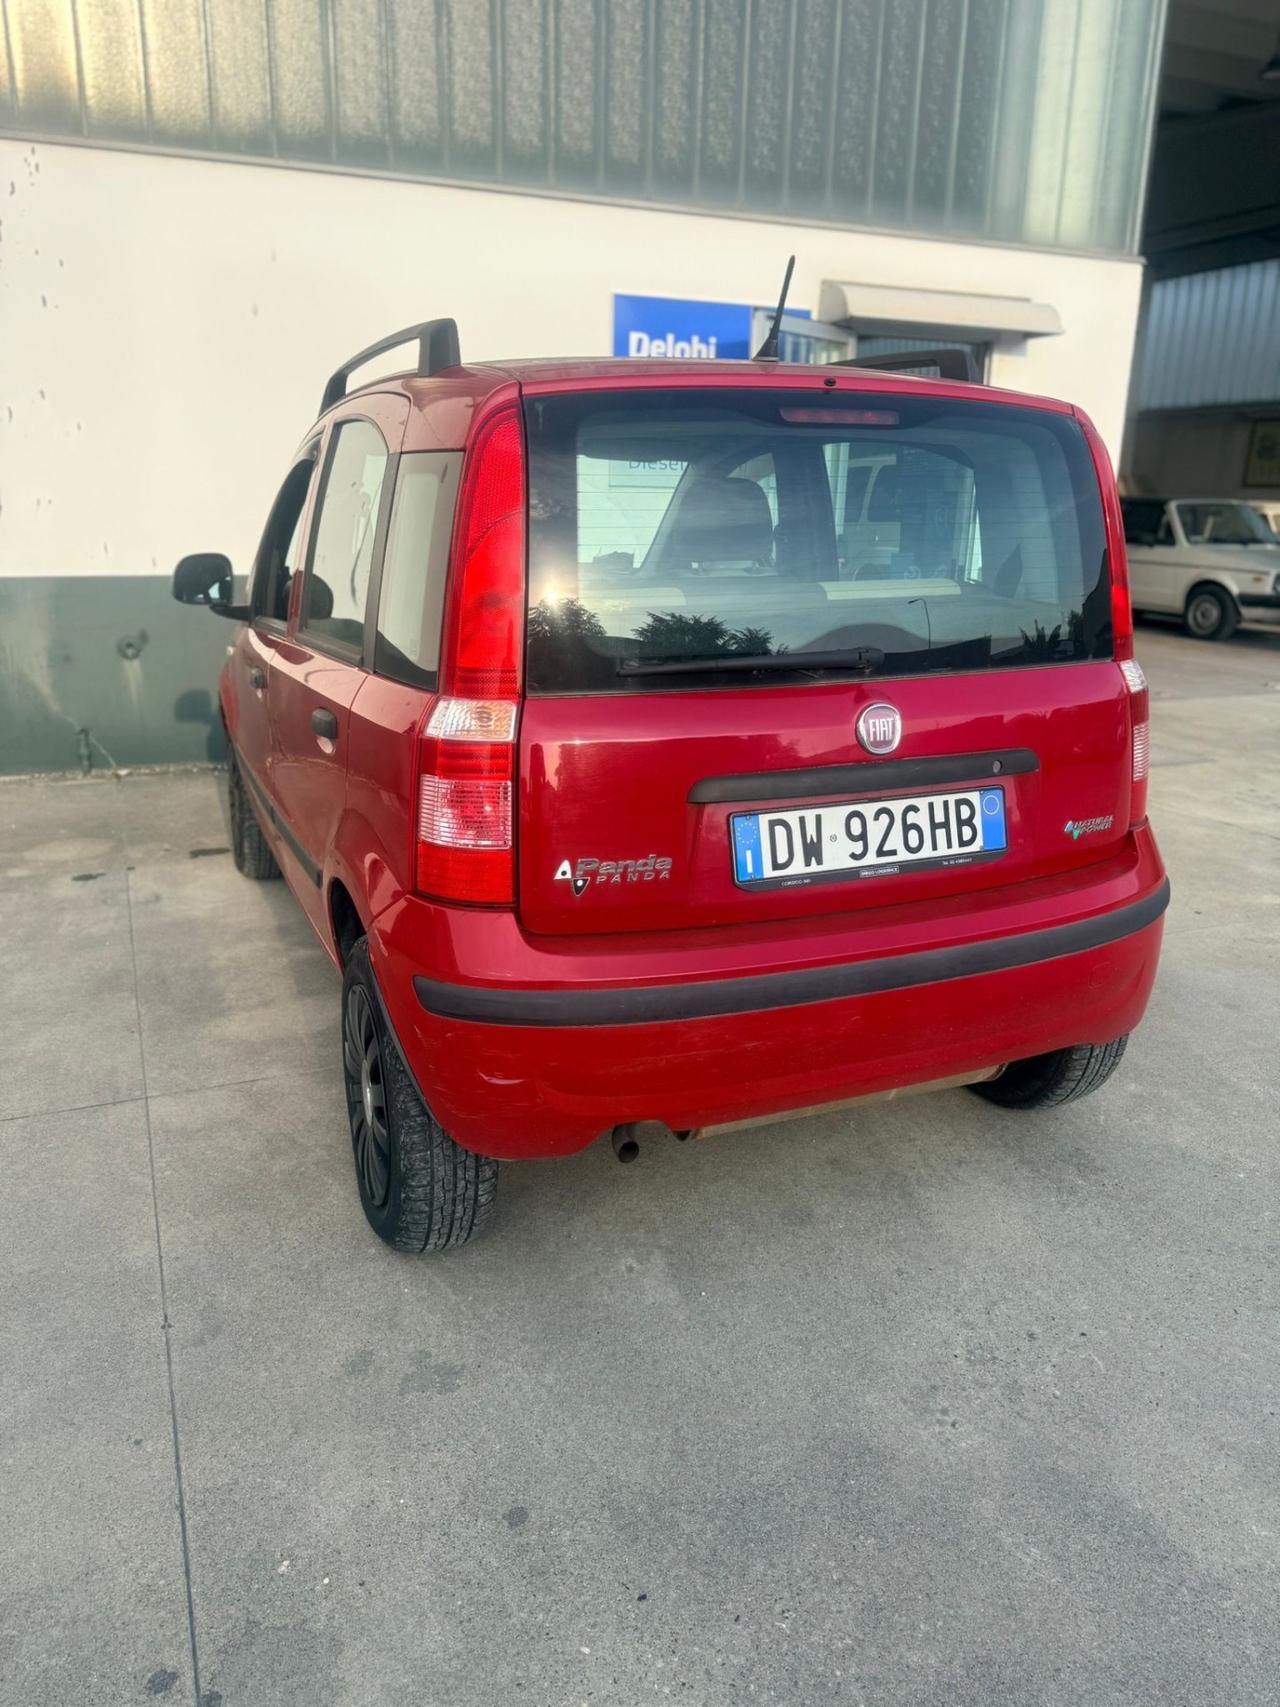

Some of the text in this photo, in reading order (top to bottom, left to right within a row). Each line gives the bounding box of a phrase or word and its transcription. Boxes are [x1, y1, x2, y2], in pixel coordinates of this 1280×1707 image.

[628, 331, 717, 358] Delphi
[868, 718, 895, 741] FIAT
[768, 814, 824, 871] DW
[844, 797, 979, 861] 926HB
[575, 854, 673, 878] Panda
[596, 871, 670, 884] PANDA
